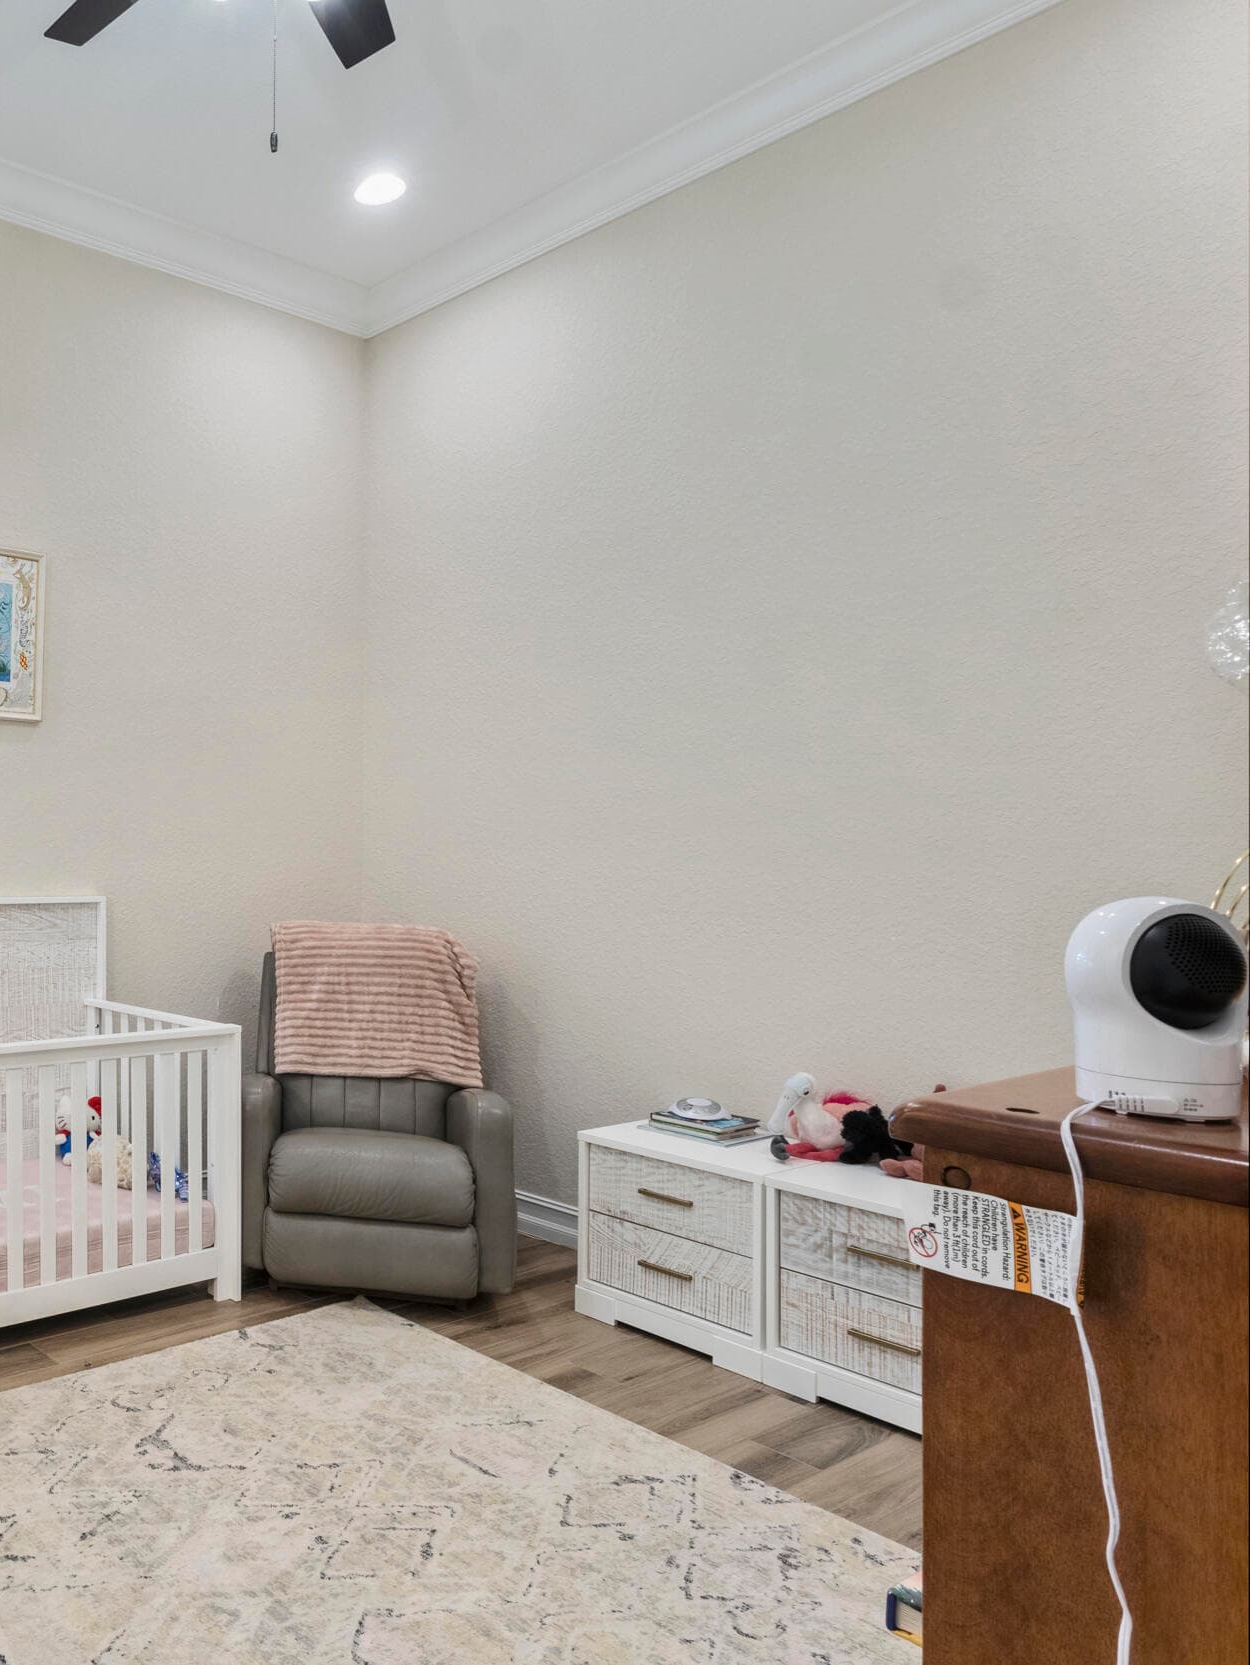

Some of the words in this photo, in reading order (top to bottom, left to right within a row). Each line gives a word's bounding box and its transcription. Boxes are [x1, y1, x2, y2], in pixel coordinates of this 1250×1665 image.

[933, 1190, 942, 1202] this
[942, 1191, 950, 1214] away).
[951, 1192, 960, 1214] (more
[971, 1196, 980, 1215] Keep
[932, 1204, 941, 1217] tag.
[943, 1216, 950, 1226] Do
[990, 1200, 999, 1231] Children
[952, 1216, 960, 1231] than
[972, 1217, 980, 1229] this
[981, 1198, 990, 1246] STRANGLED
[1000, 1202, 1010, 1250] Strangulation
[972, 1231, 980, 1248] cord
[991, 1233, 999, 1251] have
[952, 1240, 960, 1262] ft(1m)
[962, 1239, 970, 1268] children
[1015, 1223, 1029, 1284] WARNING
[972, 1263, 980, 1272] of
[981, 1256, 989, 1279] cords.
[1002, 1252, 1010, 1281] Hazard:
